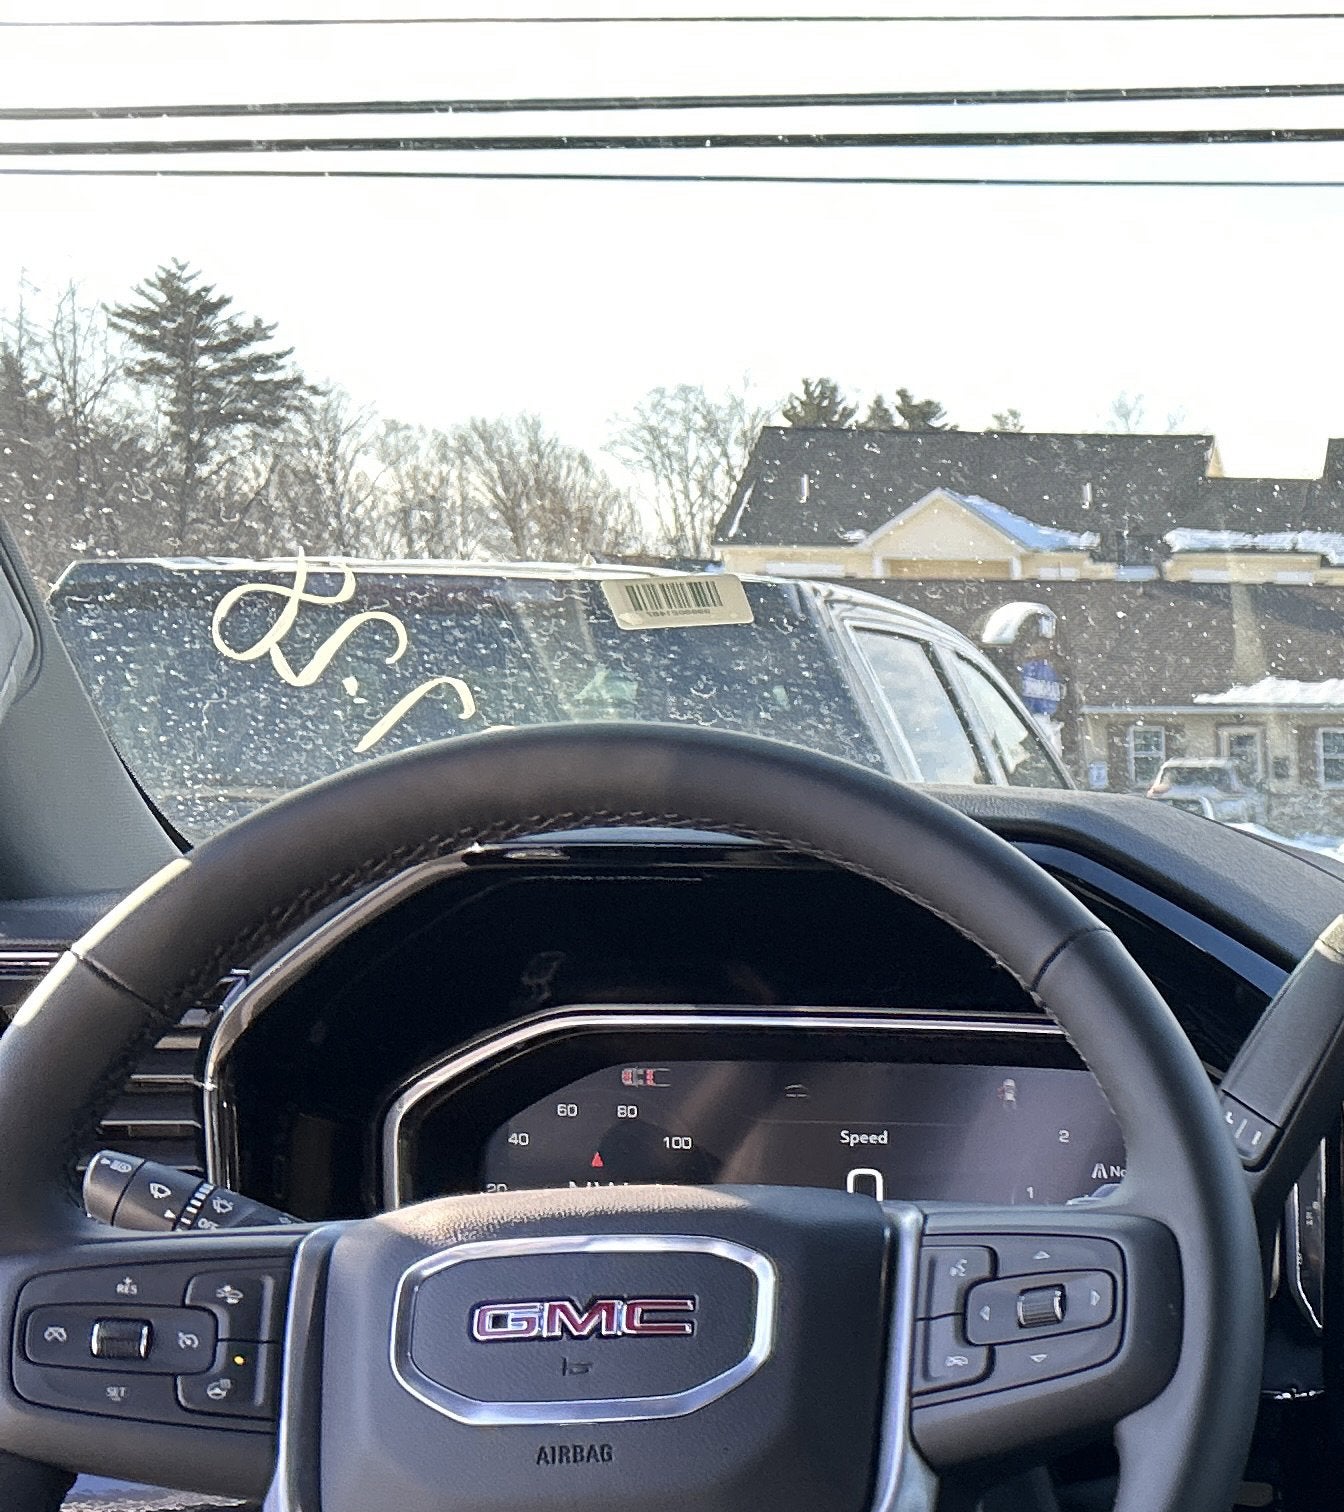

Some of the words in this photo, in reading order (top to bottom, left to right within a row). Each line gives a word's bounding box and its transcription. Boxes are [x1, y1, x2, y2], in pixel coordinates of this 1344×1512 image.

[557, 1103, 578, 1117] 60
[617, 1105, 638, 1118] 80
[507, 1132, 529, 1146] 40
[663, 1136, 693, 1150] 100
[840, 1129, 888, 1147] Speed
[1058, 1129, 1070, 1143] 2
[1026, 1186, 1035, 1199] 1
[473, 1296, 696, 1341] GMC
[536, 1443, 613, 1466] AIRBAG
